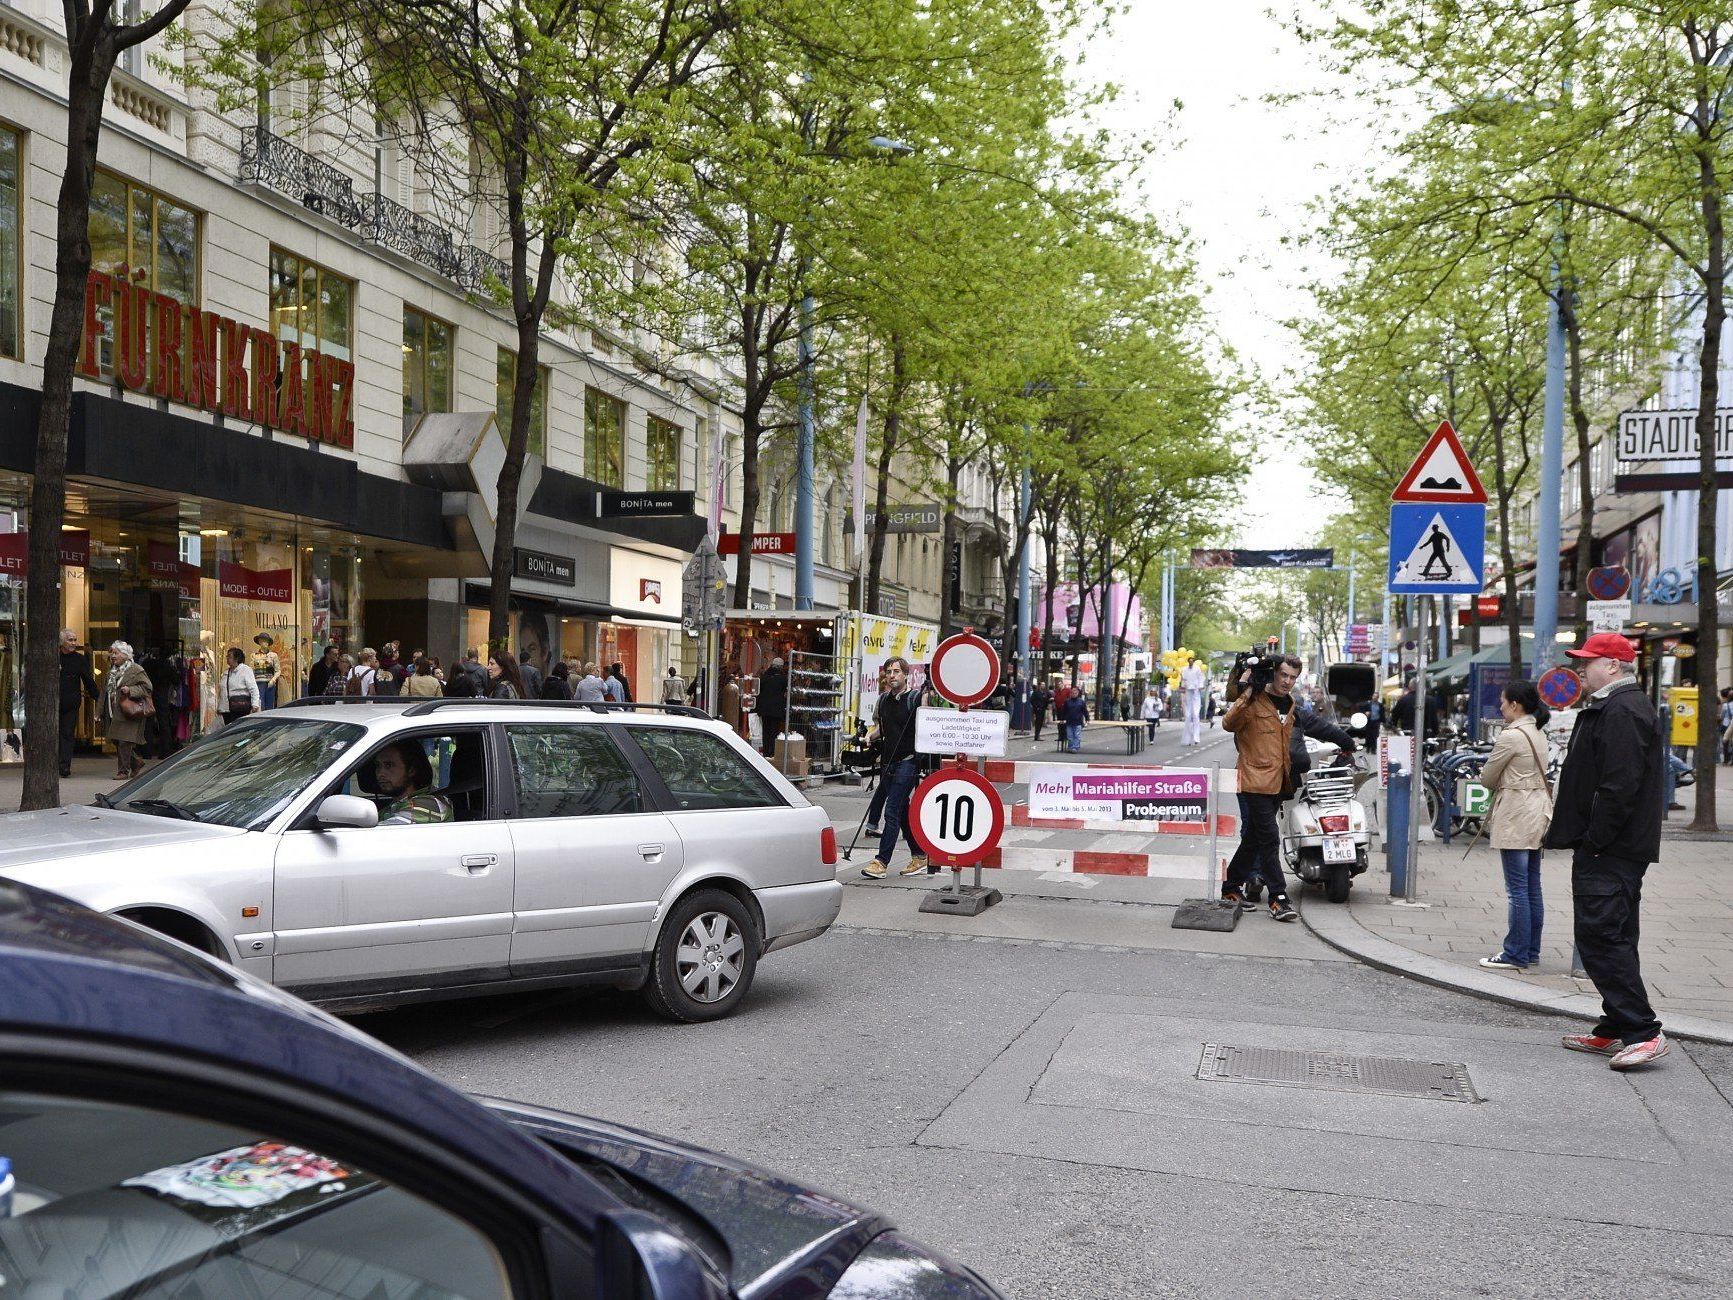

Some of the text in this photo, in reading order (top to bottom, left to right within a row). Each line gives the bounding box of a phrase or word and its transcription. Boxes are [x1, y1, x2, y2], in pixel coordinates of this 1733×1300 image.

[76, 260, 354, 450] FÜRNKRANZ
[752, 537, 781, 550] MPER
[61, 550, 85, 561] TLET
[556, 566, 569, 576] men
[223, 583, 247, 594] MODE
[257, 586, 289, 598] OUTLET
[255, 612, 288, 630] MILANO
[1012, 650, 1064, 660] ATHKE
[926, 716, 970, 724] ausgenommen
[942, 724, 981, 732] Ladetätigkeit
[954, 740, 986, 748] Radfahrer
[1036, 781, 1202, 795] Mehr Mariahilfer Straße
[1466, 784, 1490, 812] P
[1126, 804, 1202, 816] Proberaum
[935, 793, 975, 841] 10
[1333, 840, 1340, 849] W
[1327, 850, 1333, 859] 2
